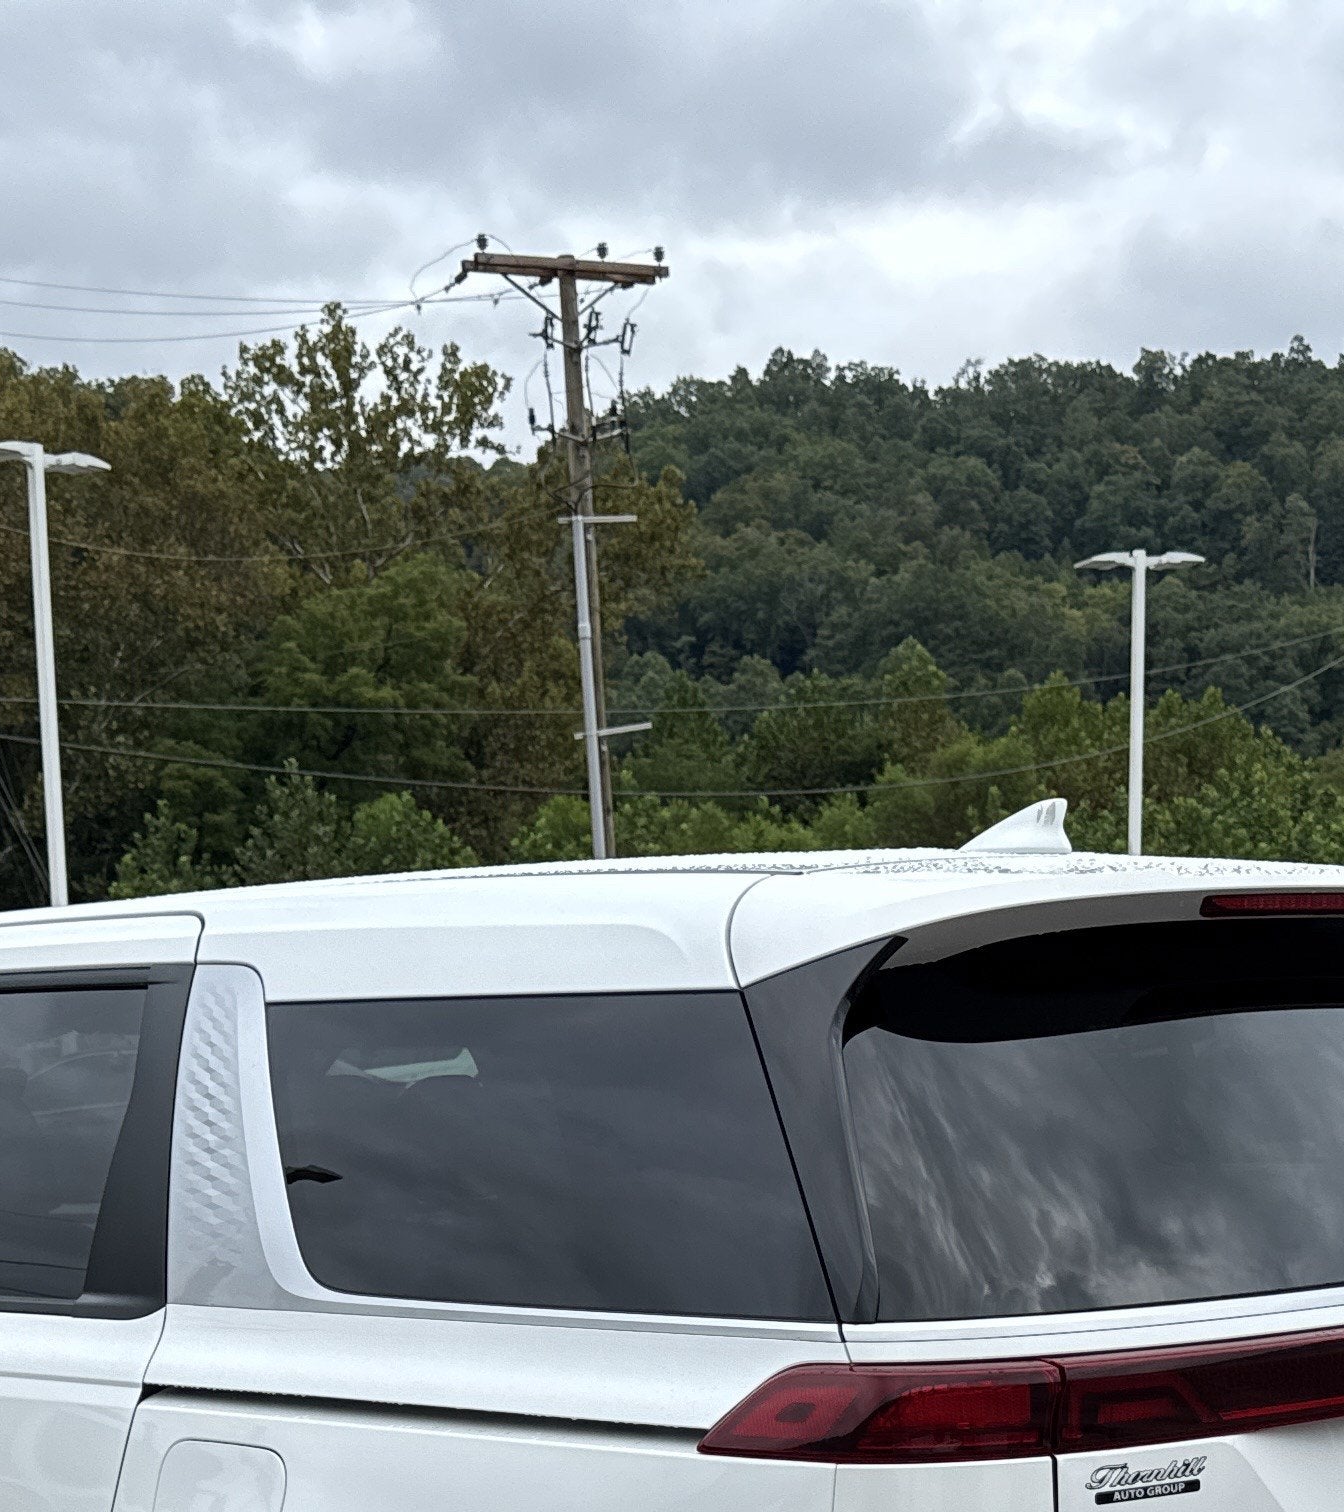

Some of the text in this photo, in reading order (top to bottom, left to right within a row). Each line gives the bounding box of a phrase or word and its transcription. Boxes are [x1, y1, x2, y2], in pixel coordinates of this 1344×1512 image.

[1085, 1456, 1207, 1490] Thornhill
[1112, 1482, 1186, 1502] AUTO GROUP
